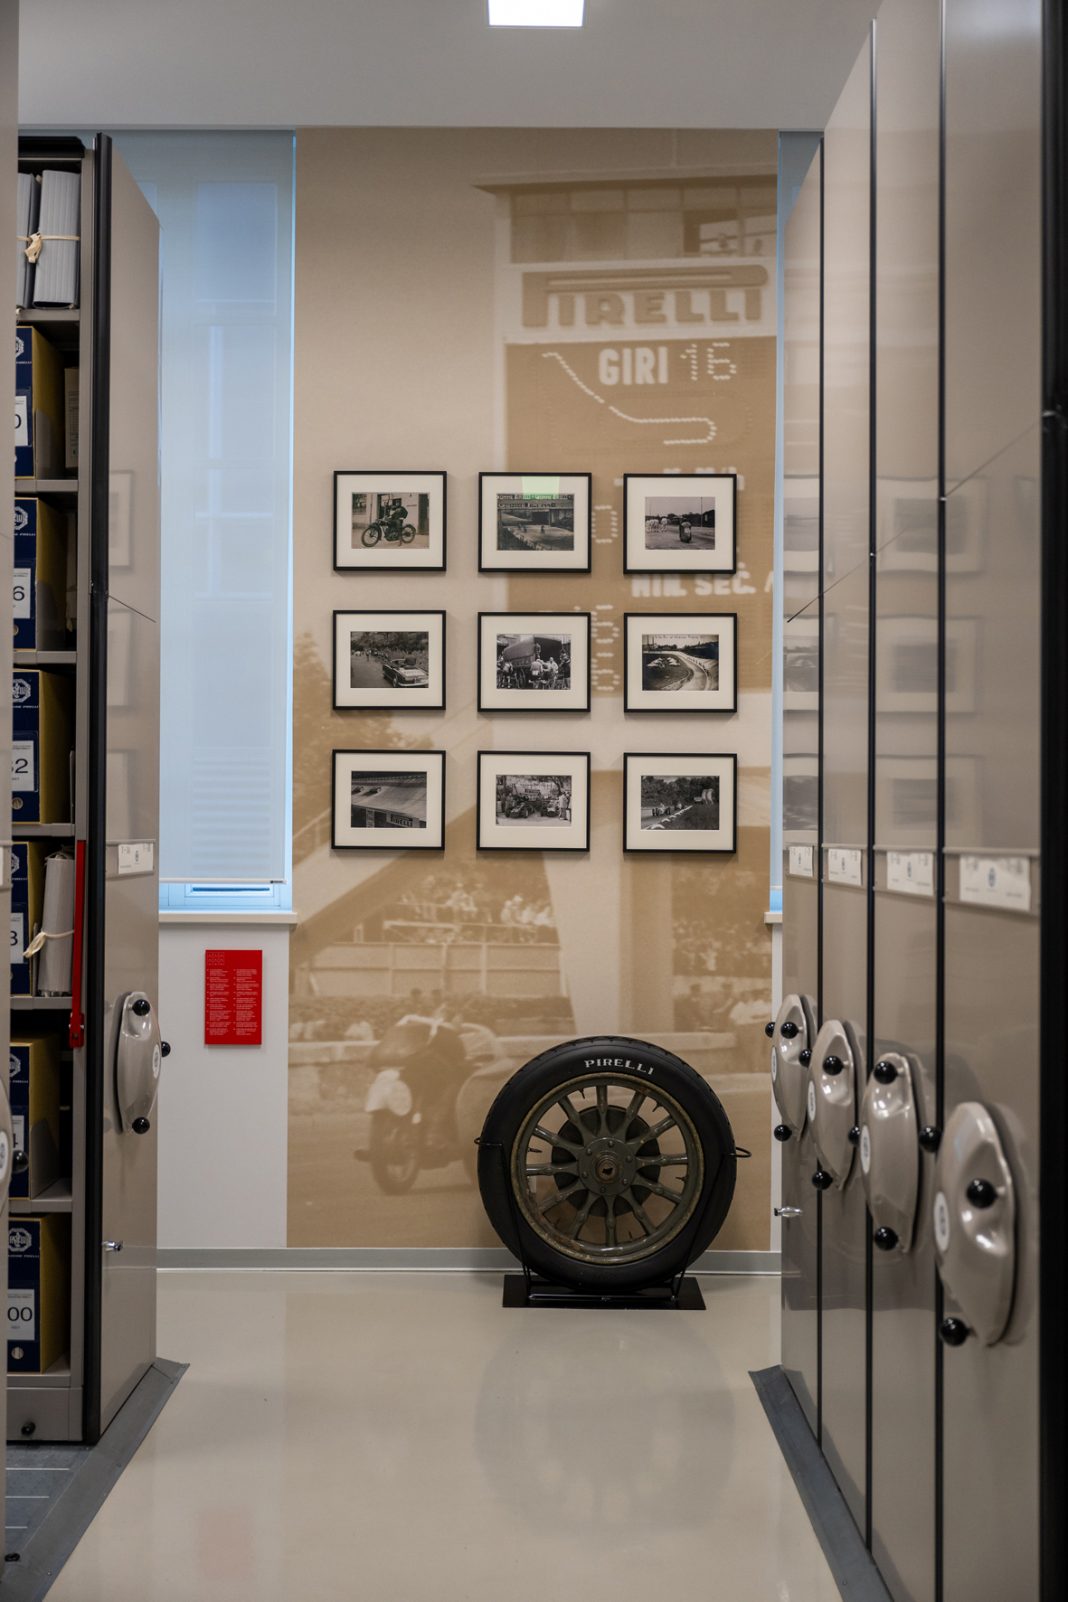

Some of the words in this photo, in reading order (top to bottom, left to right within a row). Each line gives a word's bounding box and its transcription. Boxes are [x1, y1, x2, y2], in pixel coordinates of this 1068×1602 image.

[522, 265, 768, 328] PIRELLI
[599, 347, 668, 385] GIRI
[12, 758, 29, 774] 2
[584, 1058, 654, 1075] PIRELLI
